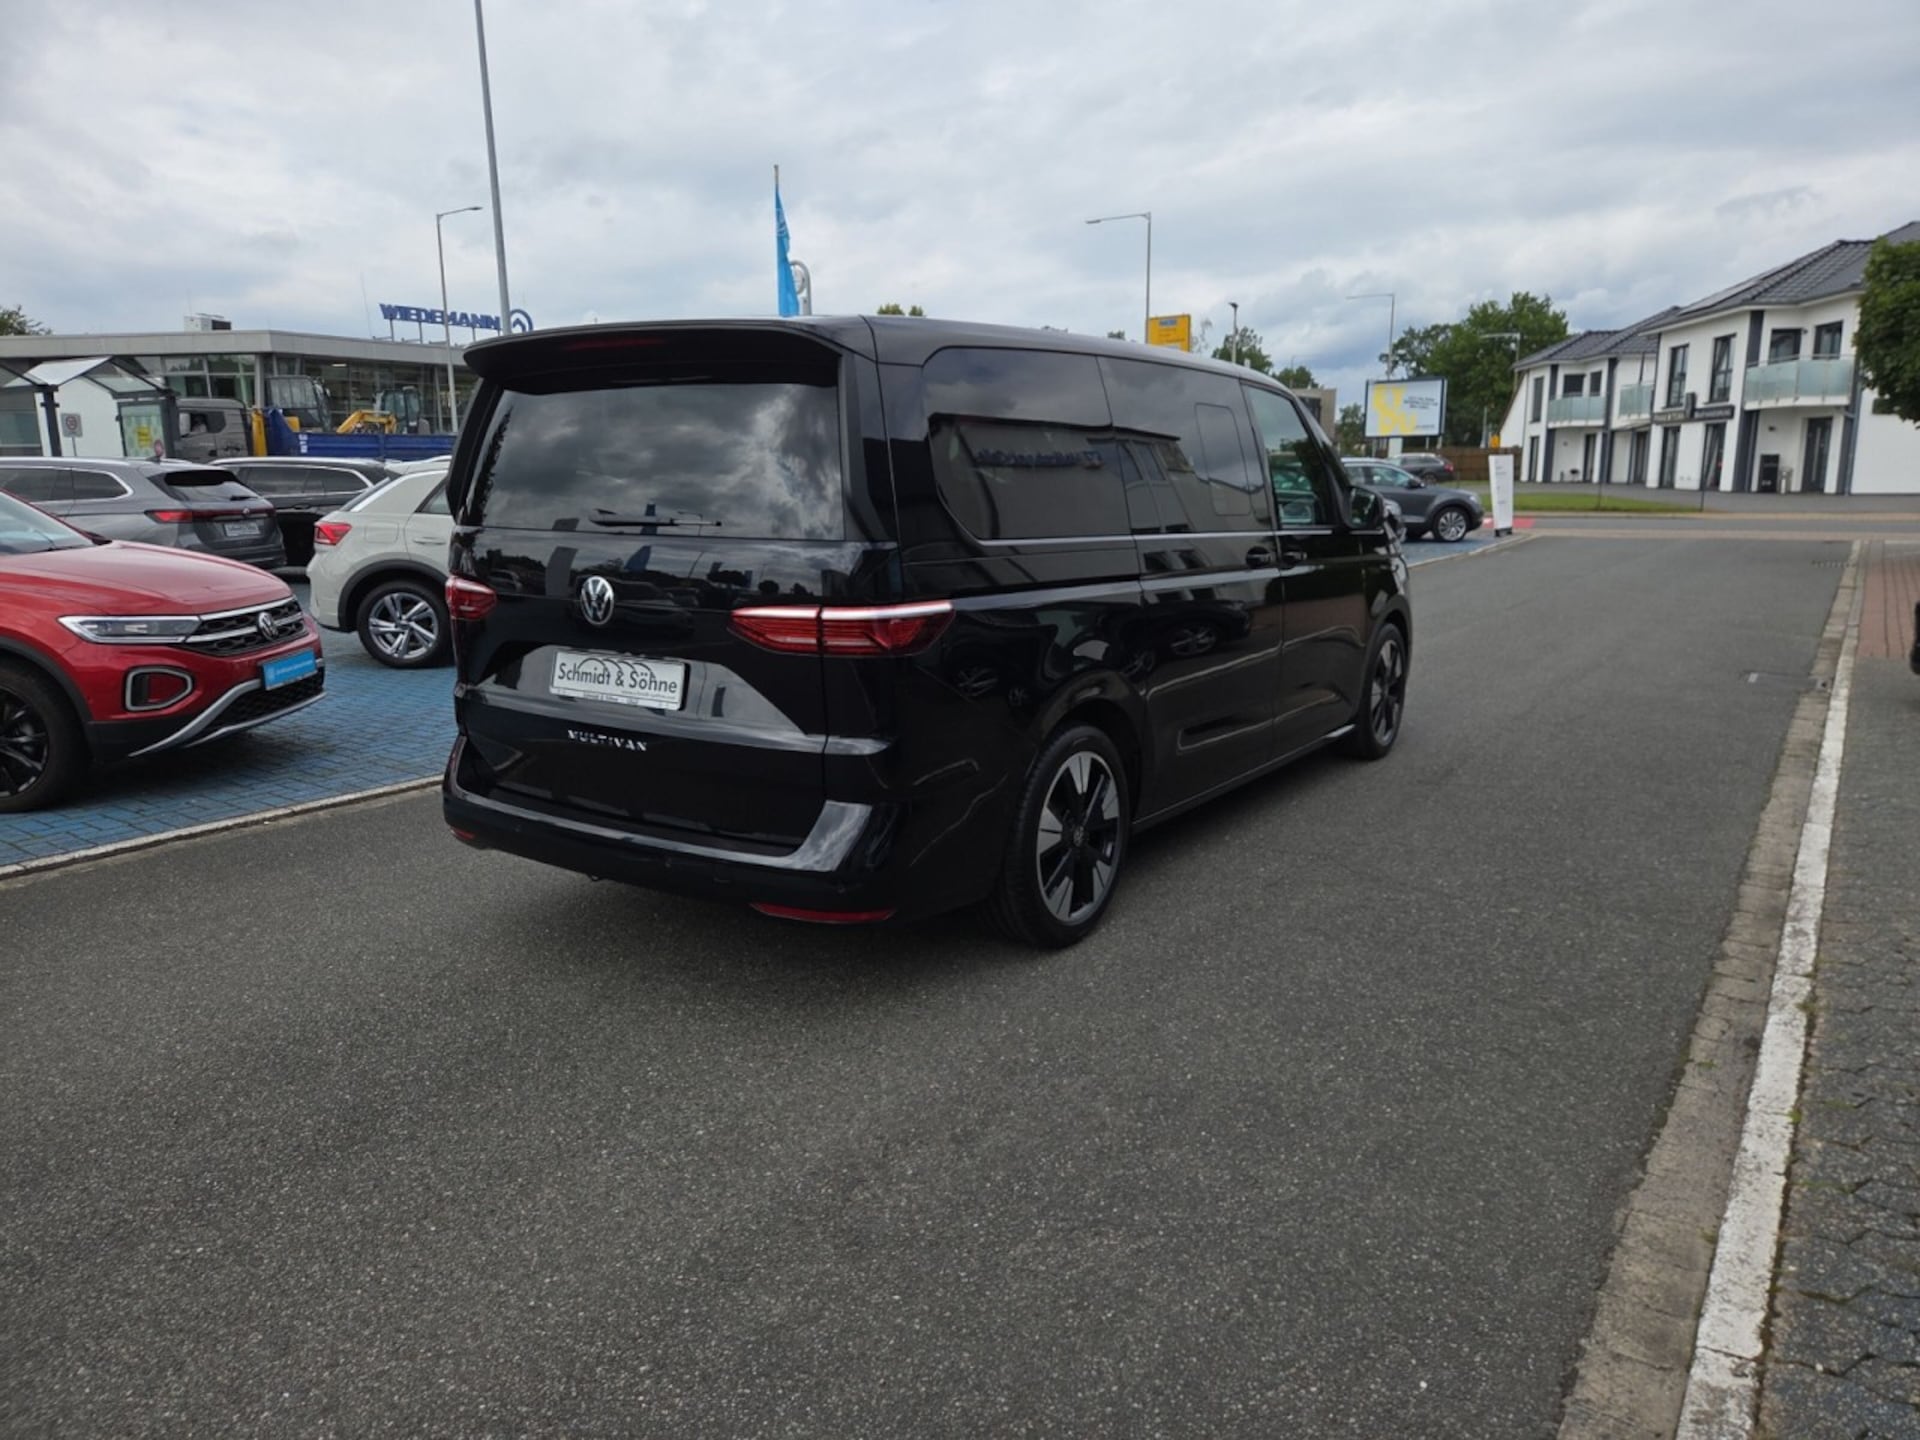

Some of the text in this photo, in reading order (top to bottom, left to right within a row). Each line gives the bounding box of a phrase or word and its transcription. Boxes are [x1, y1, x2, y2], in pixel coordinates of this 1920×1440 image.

[558, 663, 677, 693] Schmidt & Söhne
